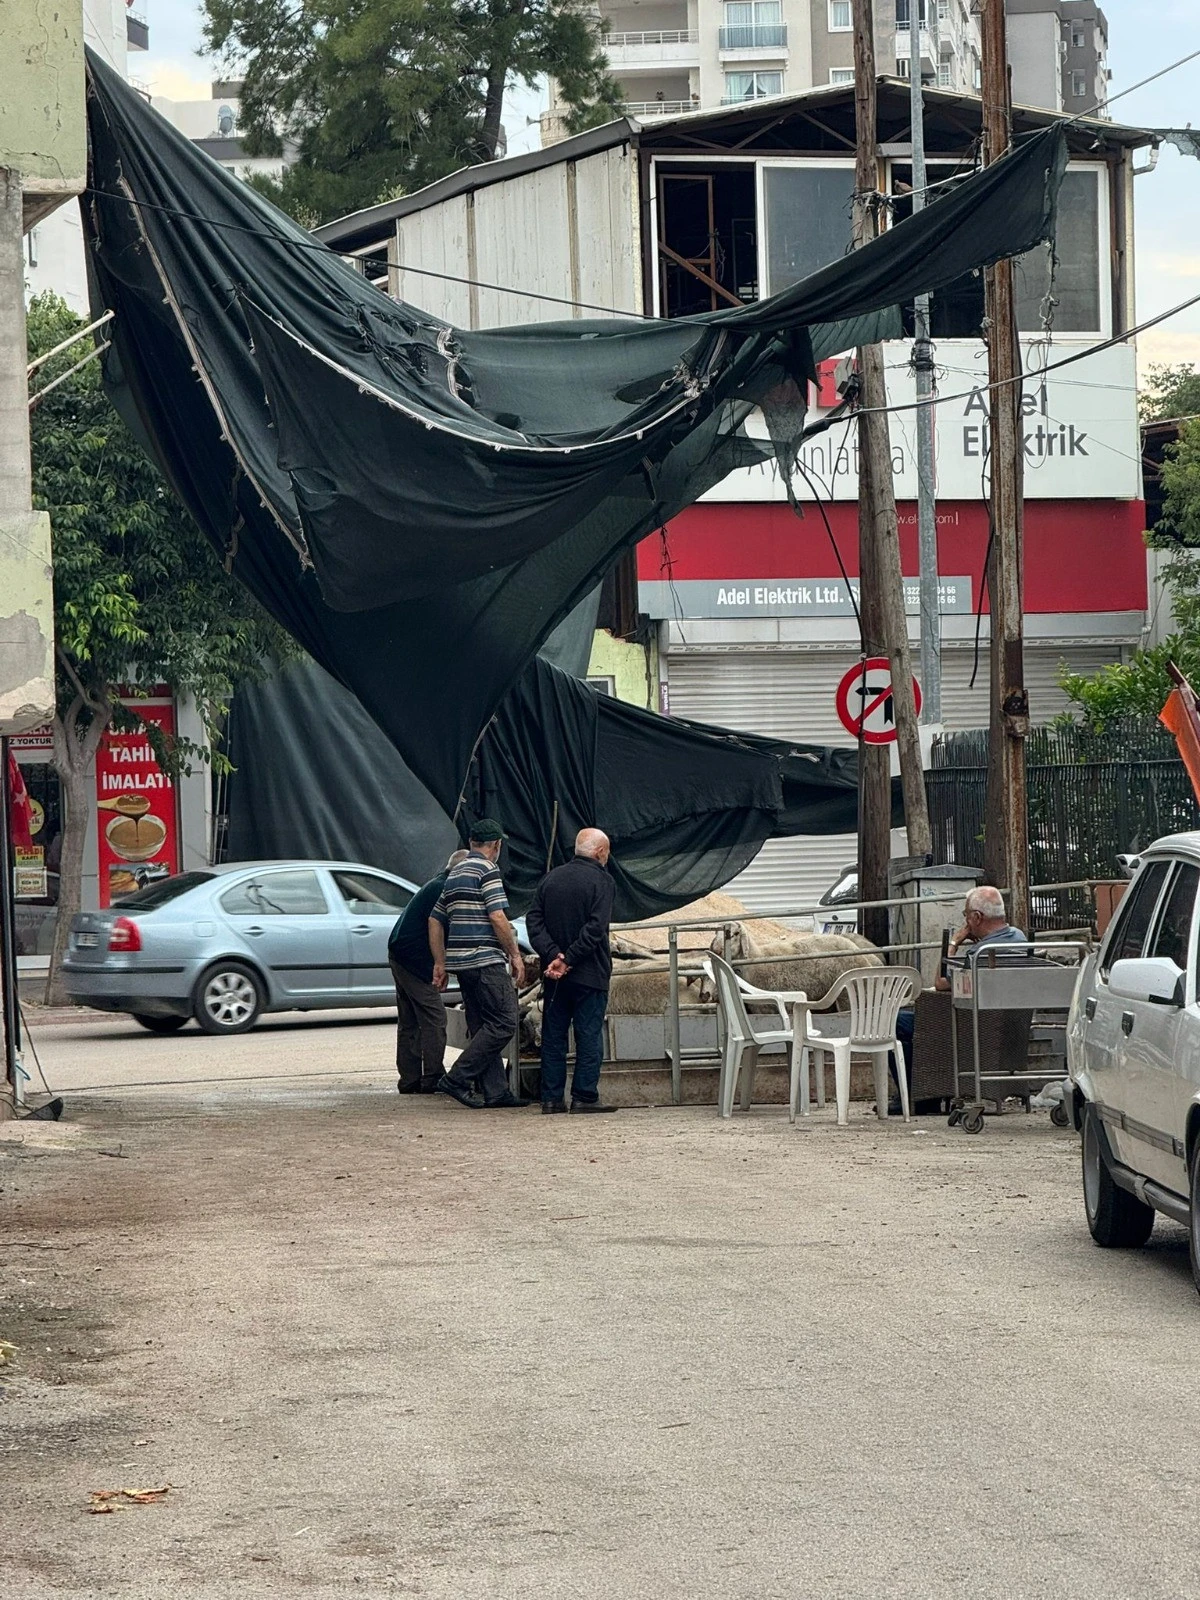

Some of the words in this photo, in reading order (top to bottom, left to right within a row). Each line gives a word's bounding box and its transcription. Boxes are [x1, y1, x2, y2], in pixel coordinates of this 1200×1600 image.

[963, 385, 1048, 416] Ael
[963, 424, 1089, 456] Elktrik
[716, 588, 750, 605] Adel
[754, 587, 811, 605] Elektrik
[815, 587, 844, 604] Ltd.
